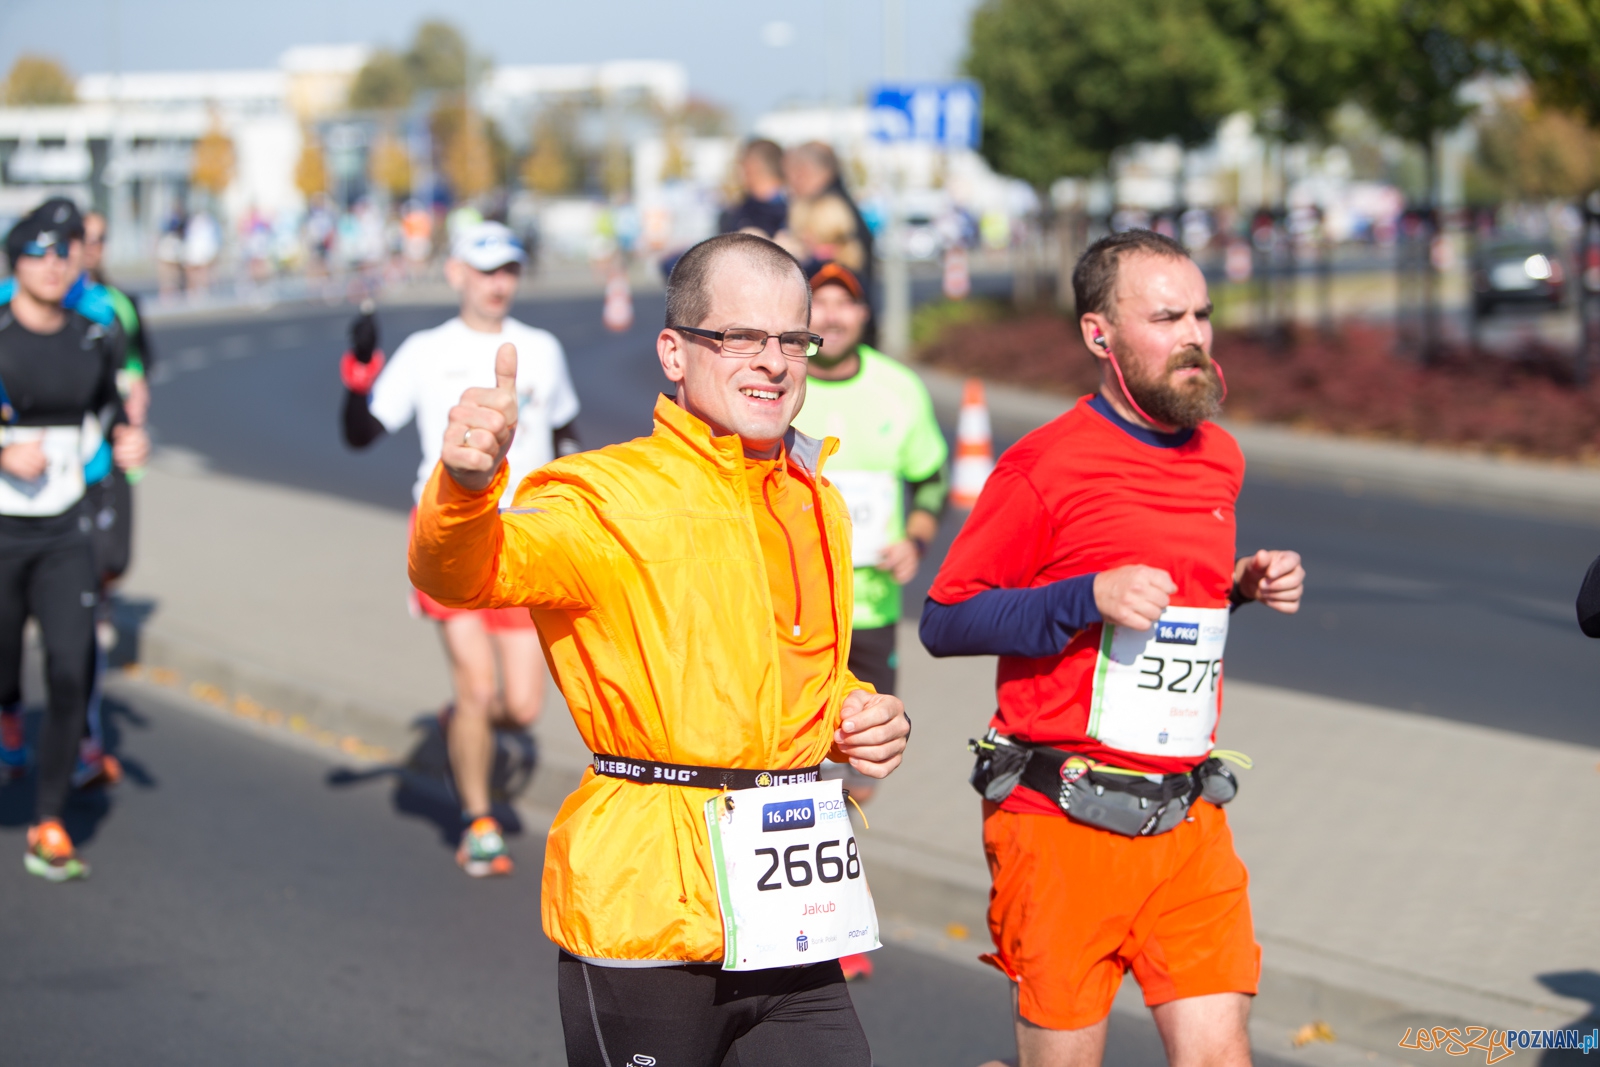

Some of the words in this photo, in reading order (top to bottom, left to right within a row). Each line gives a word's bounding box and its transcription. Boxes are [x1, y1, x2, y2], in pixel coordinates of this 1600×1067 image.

[785, 807, 812, 822] PKO
[755, 836, 860, 892] 2668
[802, 901, 836, 916] Jakub
